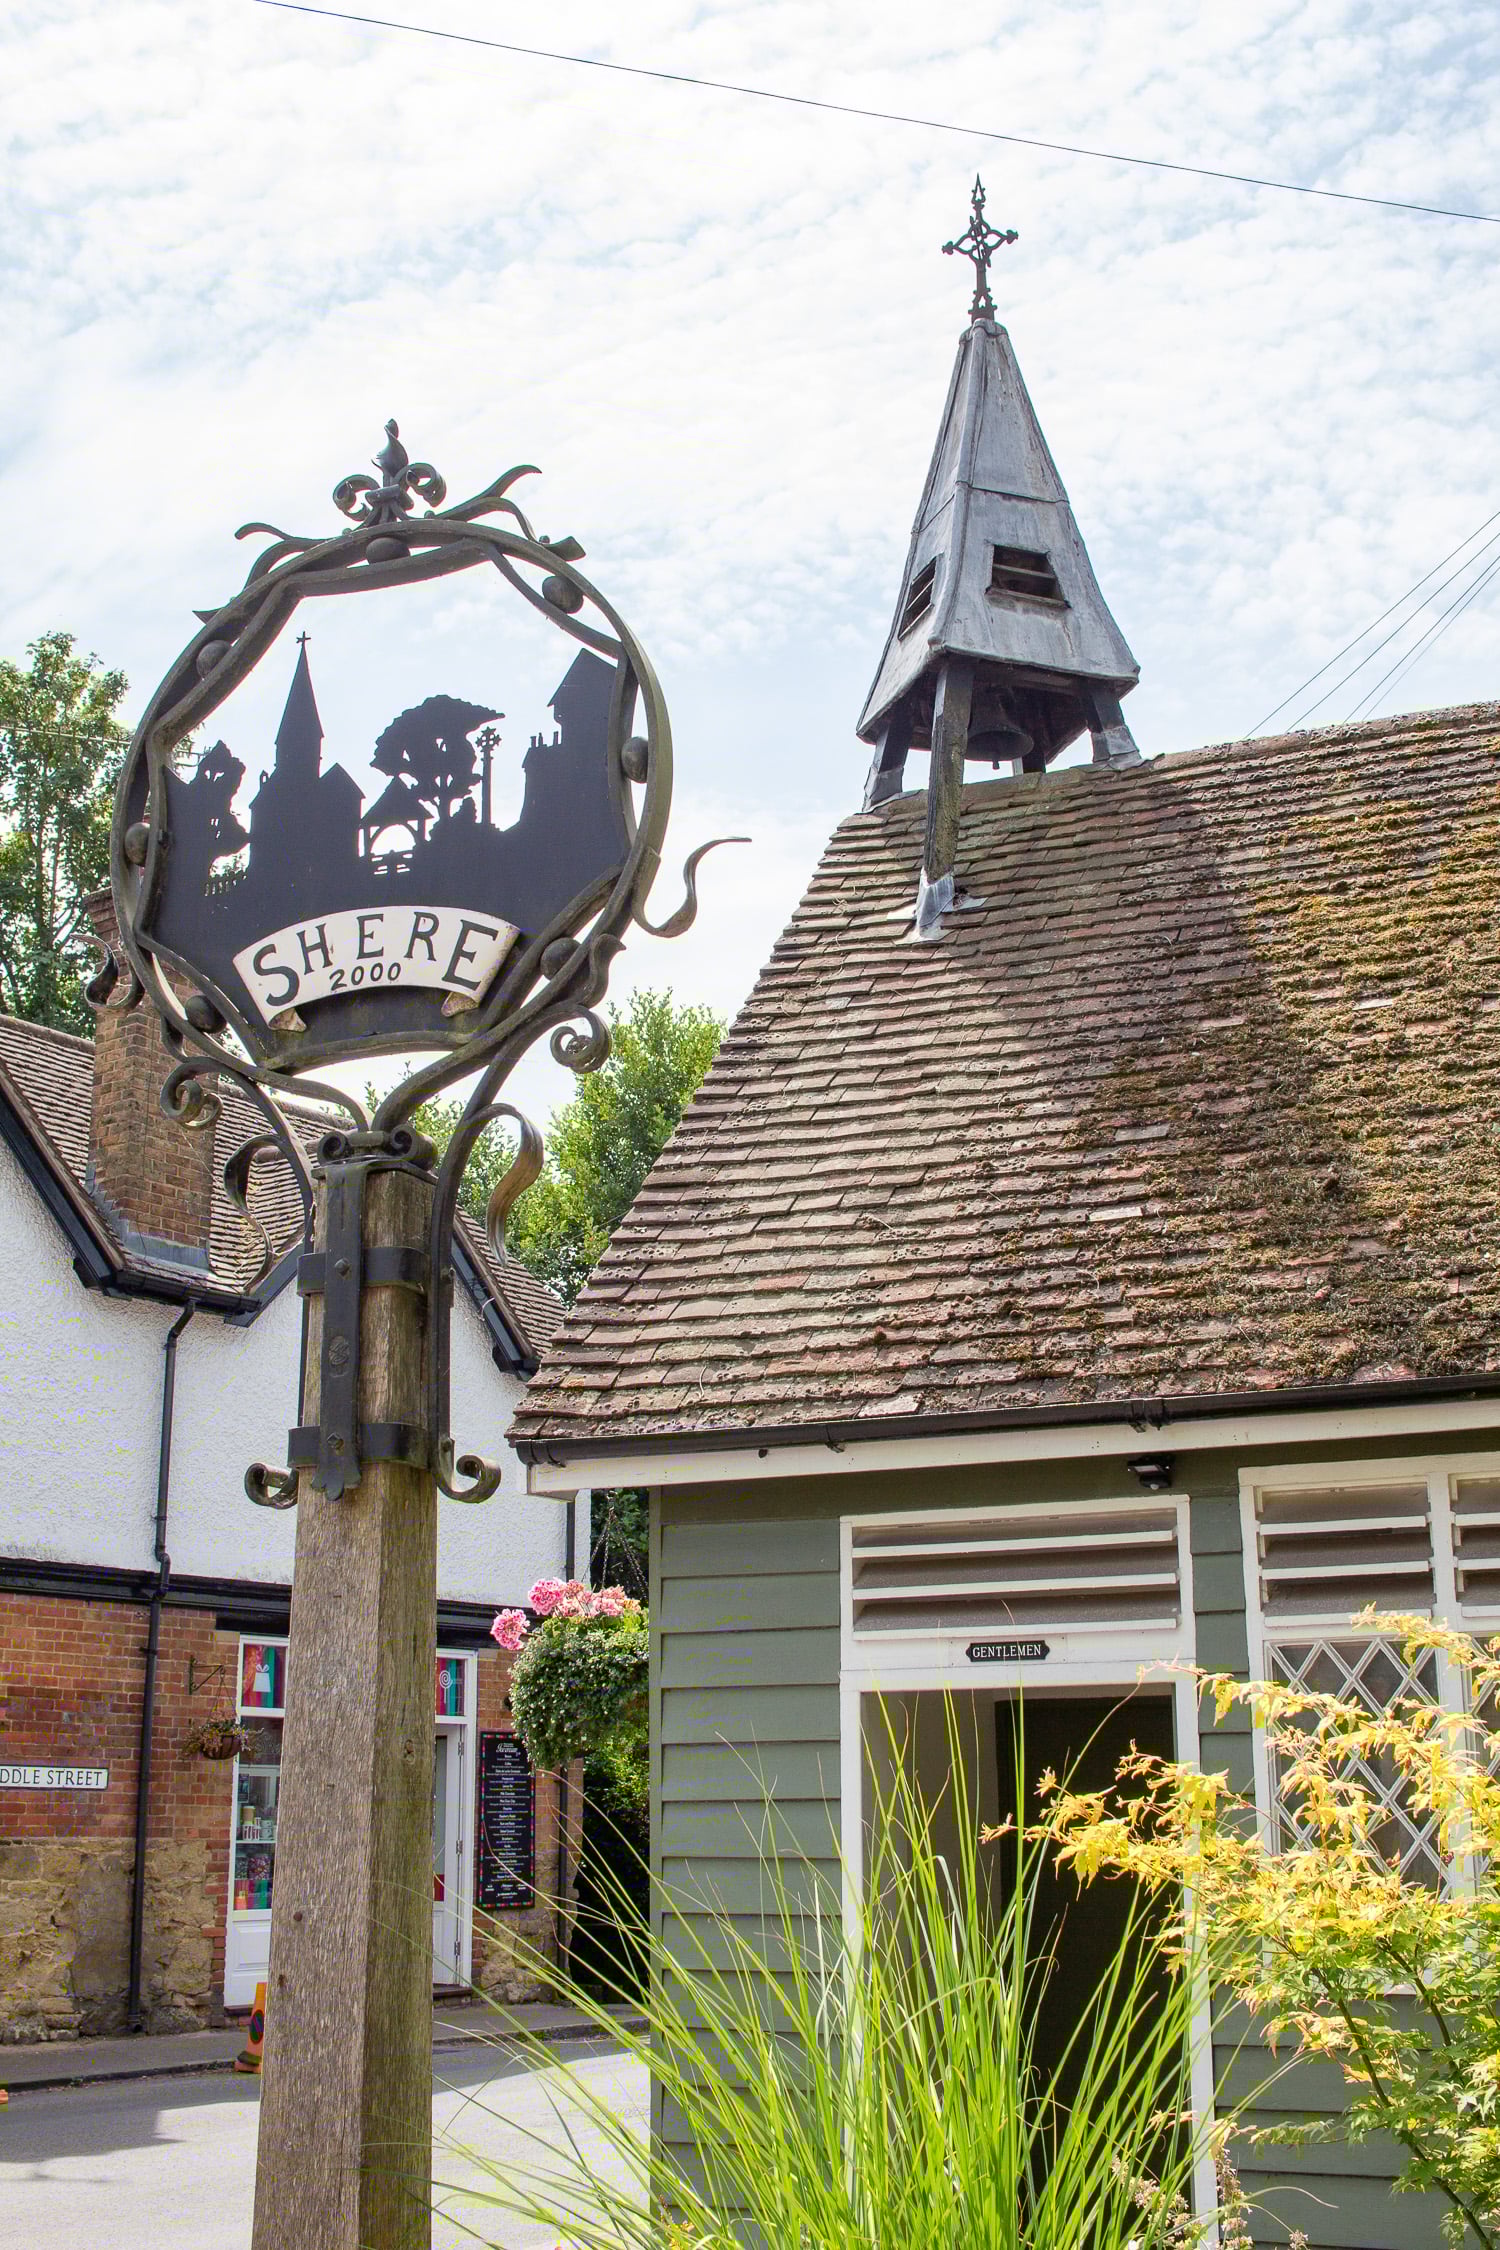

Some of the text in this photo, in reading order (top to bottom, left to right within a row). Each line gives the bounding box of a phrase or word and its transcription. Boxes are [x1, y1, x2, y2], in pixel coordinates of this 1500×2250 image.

[253, 911, 499, 1006] SHERE
[329, 962, 402, 991] 2000
[972, 1644, 1042, 1658] GENTLEMEN
[0, 1768, 102, 1785] DDLE STREET
